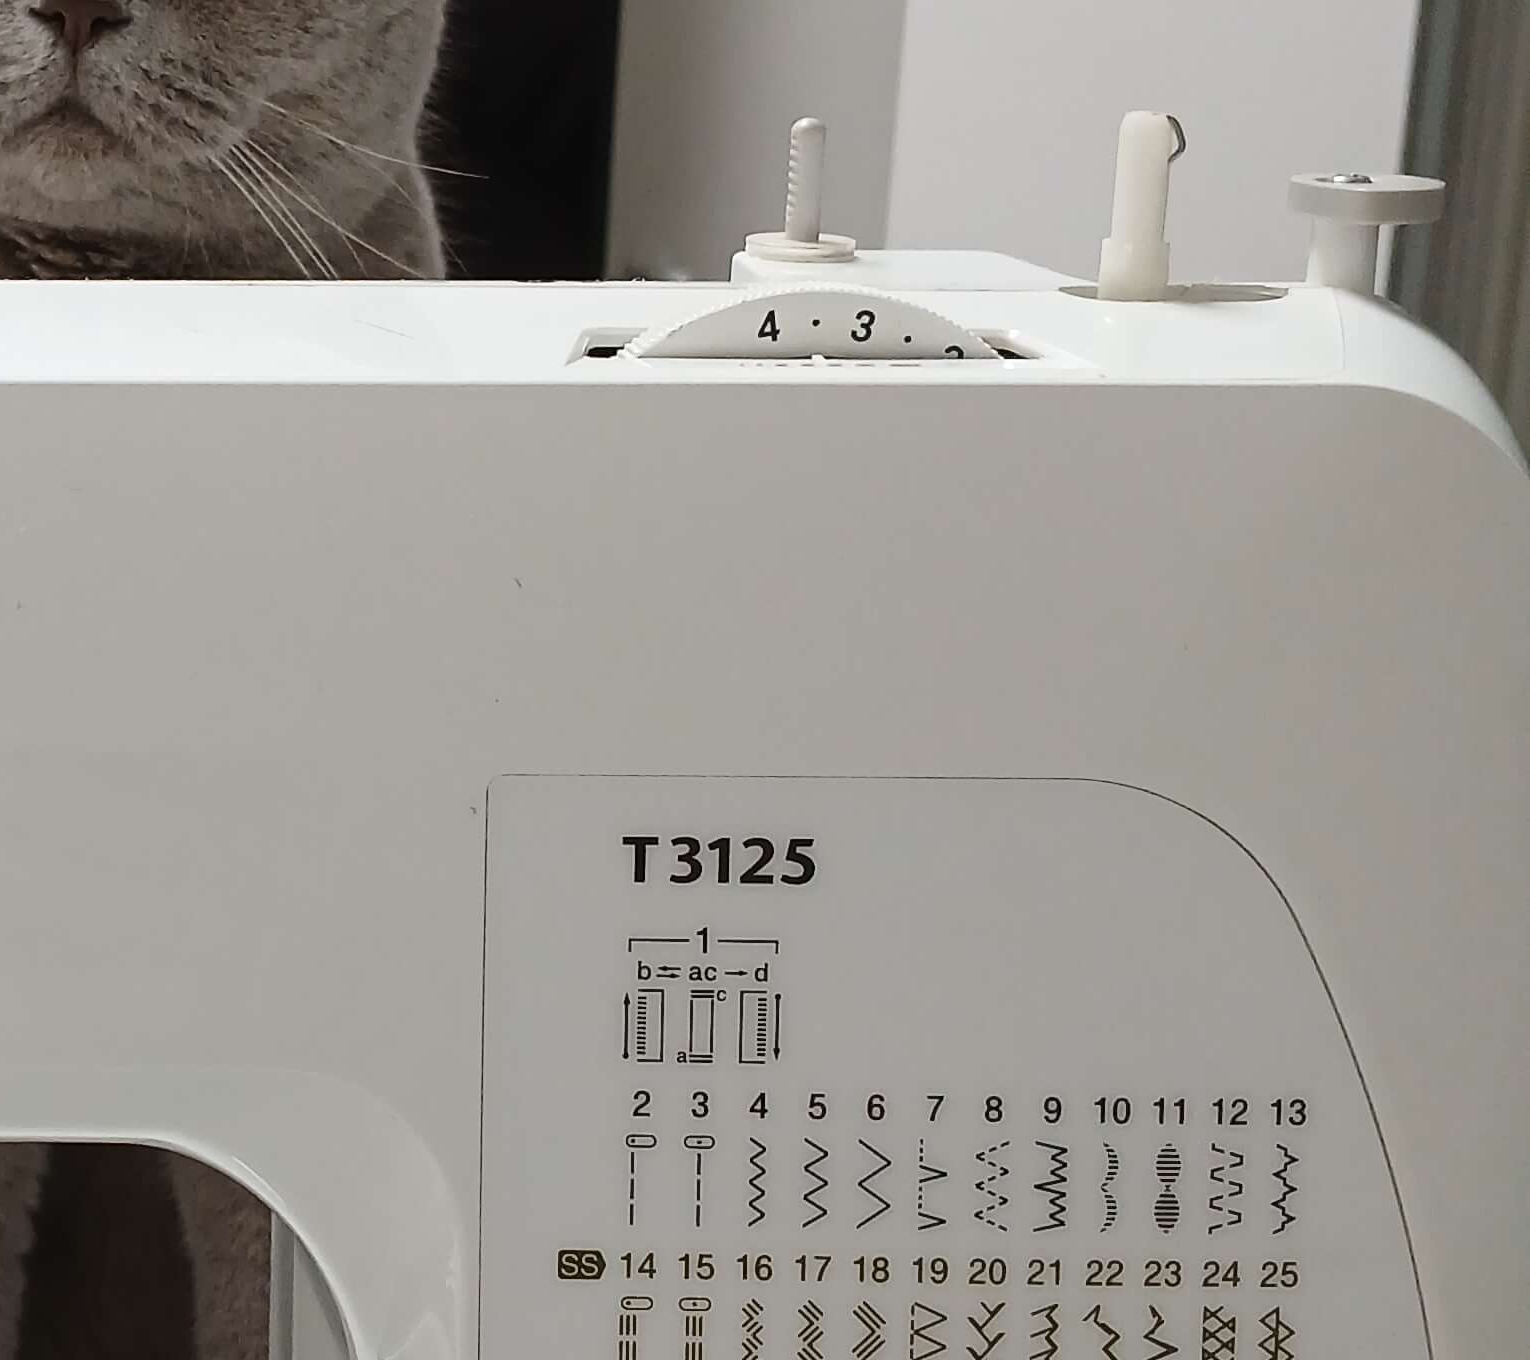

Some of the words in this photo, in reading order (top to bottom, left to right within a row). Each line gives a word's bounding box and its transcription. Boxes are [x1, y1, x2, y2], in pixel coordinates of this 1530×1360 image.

[758, 310, 780, 341] 4
[851, 310, 875, 342] 3
[623, 837, 815, 885] T3125
[697, 927, 707, 953] 1
[638, 961, 651, 980] b
[689, 966, 716, 981] ac
[755, 963, 768, 982] d
[633, 1091, 650, 1116] 2
[692, 1092, 708, 1117] 3
[750, 1093, 768, 1118] 4
[809, 1094, 826, 1119] 5
[868, 1094, 885, 1120] 6
[927, 1096, 944, 1121] 7
[985, 1096, 1002, 1122] 8
[1044, 1097, 1061, 1123] 9
[1095, 1098, 1130, 1124] 10
[1153, 1098, 1184, 1124] 11
[1213, 1098, 1247, 1125] 12
[1271, 1099, 1306, 1125] 13
[560, 1253, 600, 1276] SS
[621, 1253, 656, 1279] 14
[679, 1254, 714, 1280] 15
[737, 1254, 772, 1281] 16
[796, 1255, 831, 1281] 17
[854, 1256, 889, 1283] 18
[913, 1257, 948, 1284] 19
[969, 1258, 1006, 1285] 20
[1027, 1260, 1060, 1285] 21
[1086, 1260, 1123, 1286] 22
[1144, 1261, 1181, 1287] 23
[1202, 1261, 1240, 1287] 24
[1260, 1261, 1298, 1287] 25
